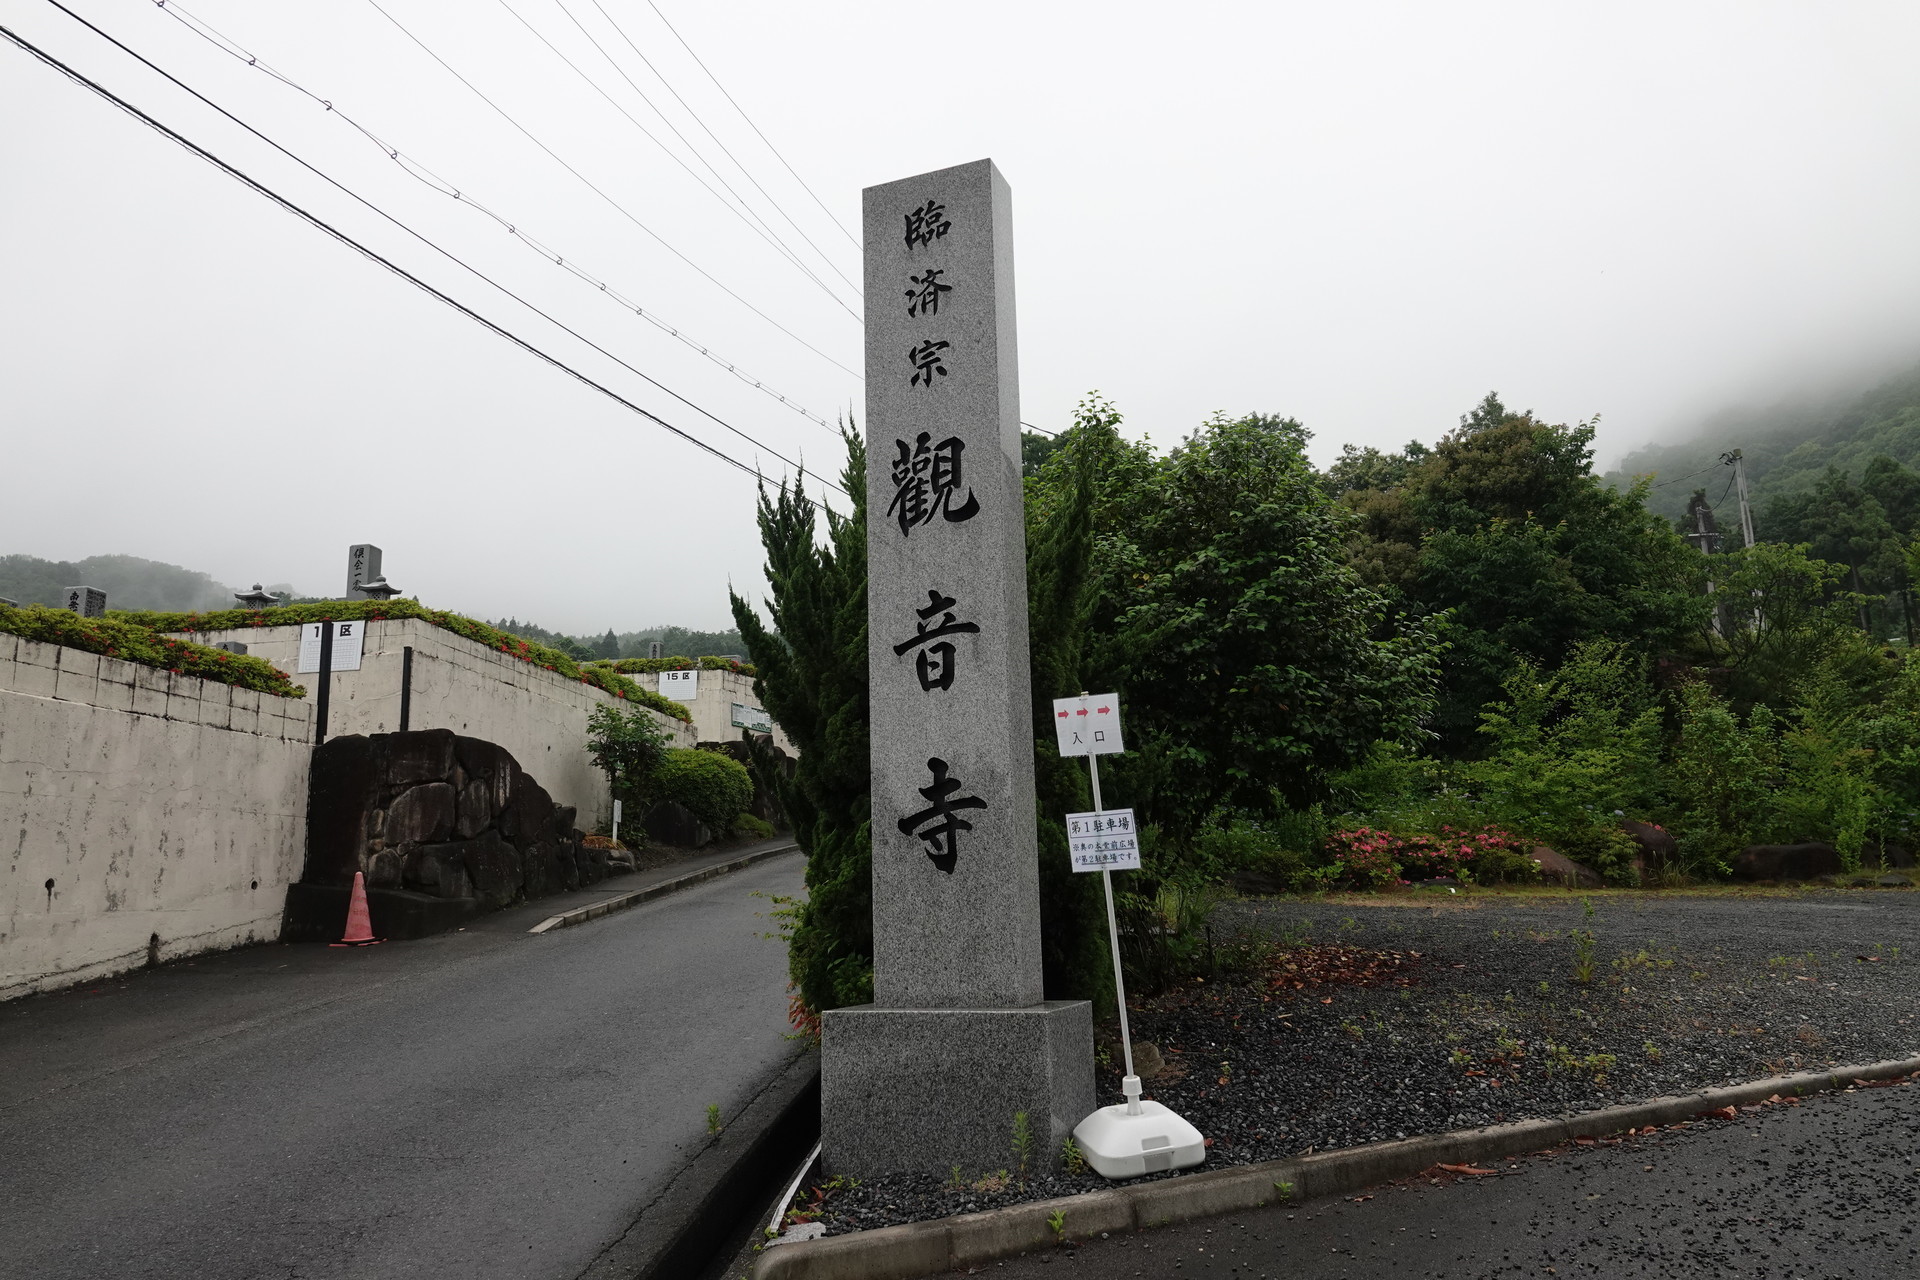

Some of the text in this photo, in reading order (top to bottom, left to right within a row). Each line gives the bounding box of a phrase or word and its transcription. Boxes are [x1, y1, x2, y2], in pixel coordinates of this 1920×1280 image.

[904, 200, 952, 388] 臨済宗
[1072, 731, 1105, 745] 入口
[1070, 816, 1130, 834] 第1駐車場
